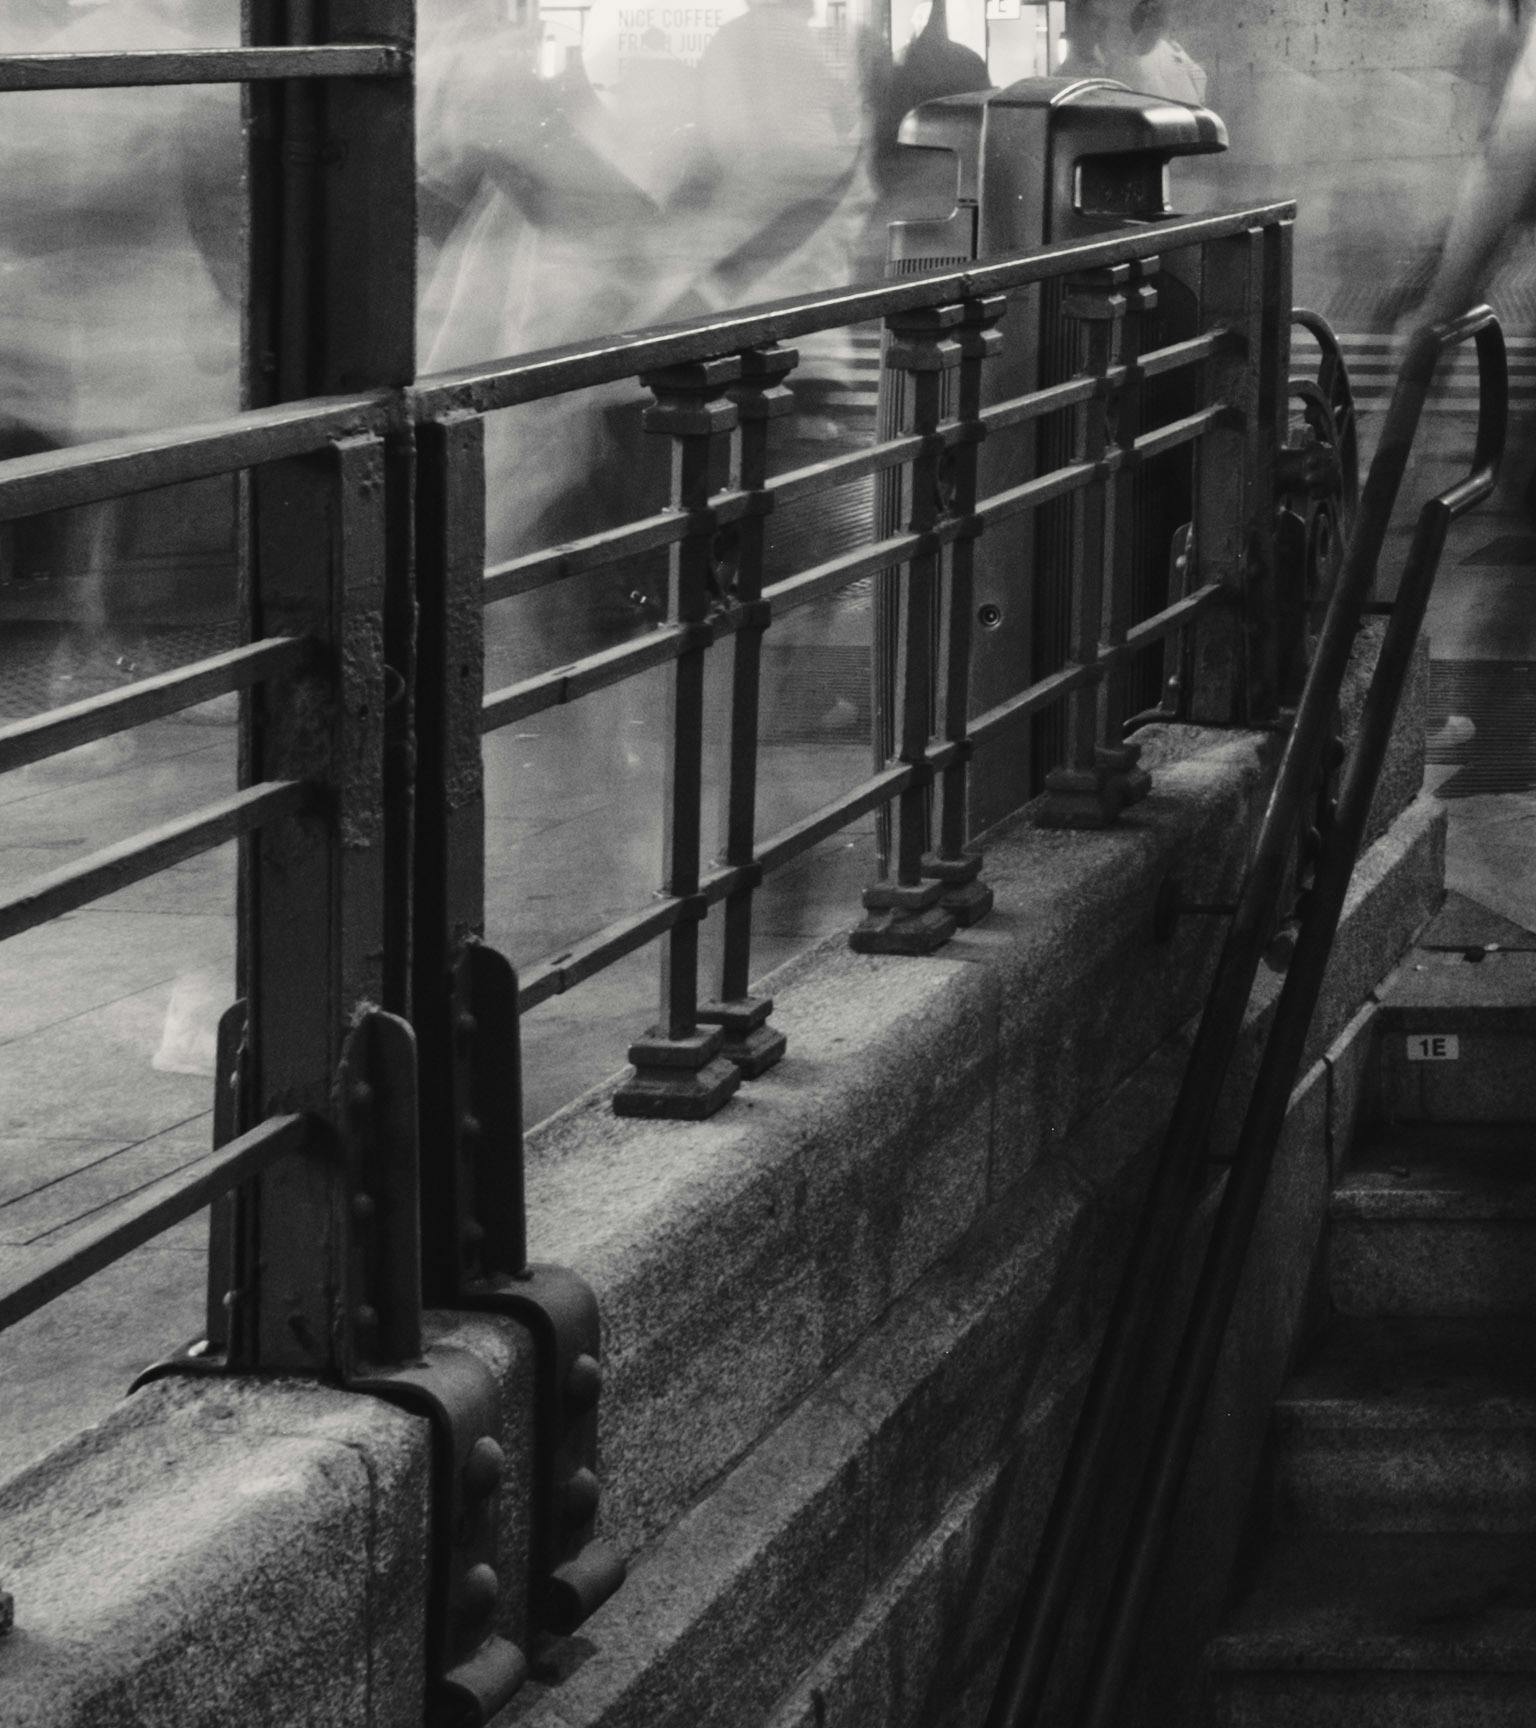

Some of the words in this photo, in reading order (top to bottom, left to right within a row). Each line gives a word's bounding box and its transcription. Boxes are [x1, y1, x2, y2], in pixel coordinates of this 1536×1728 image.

[618, 8, 655, 28] NICE
[661, 8, 724, 29] COFFEE
[1419, 1038, 1446, 1057] 1E
